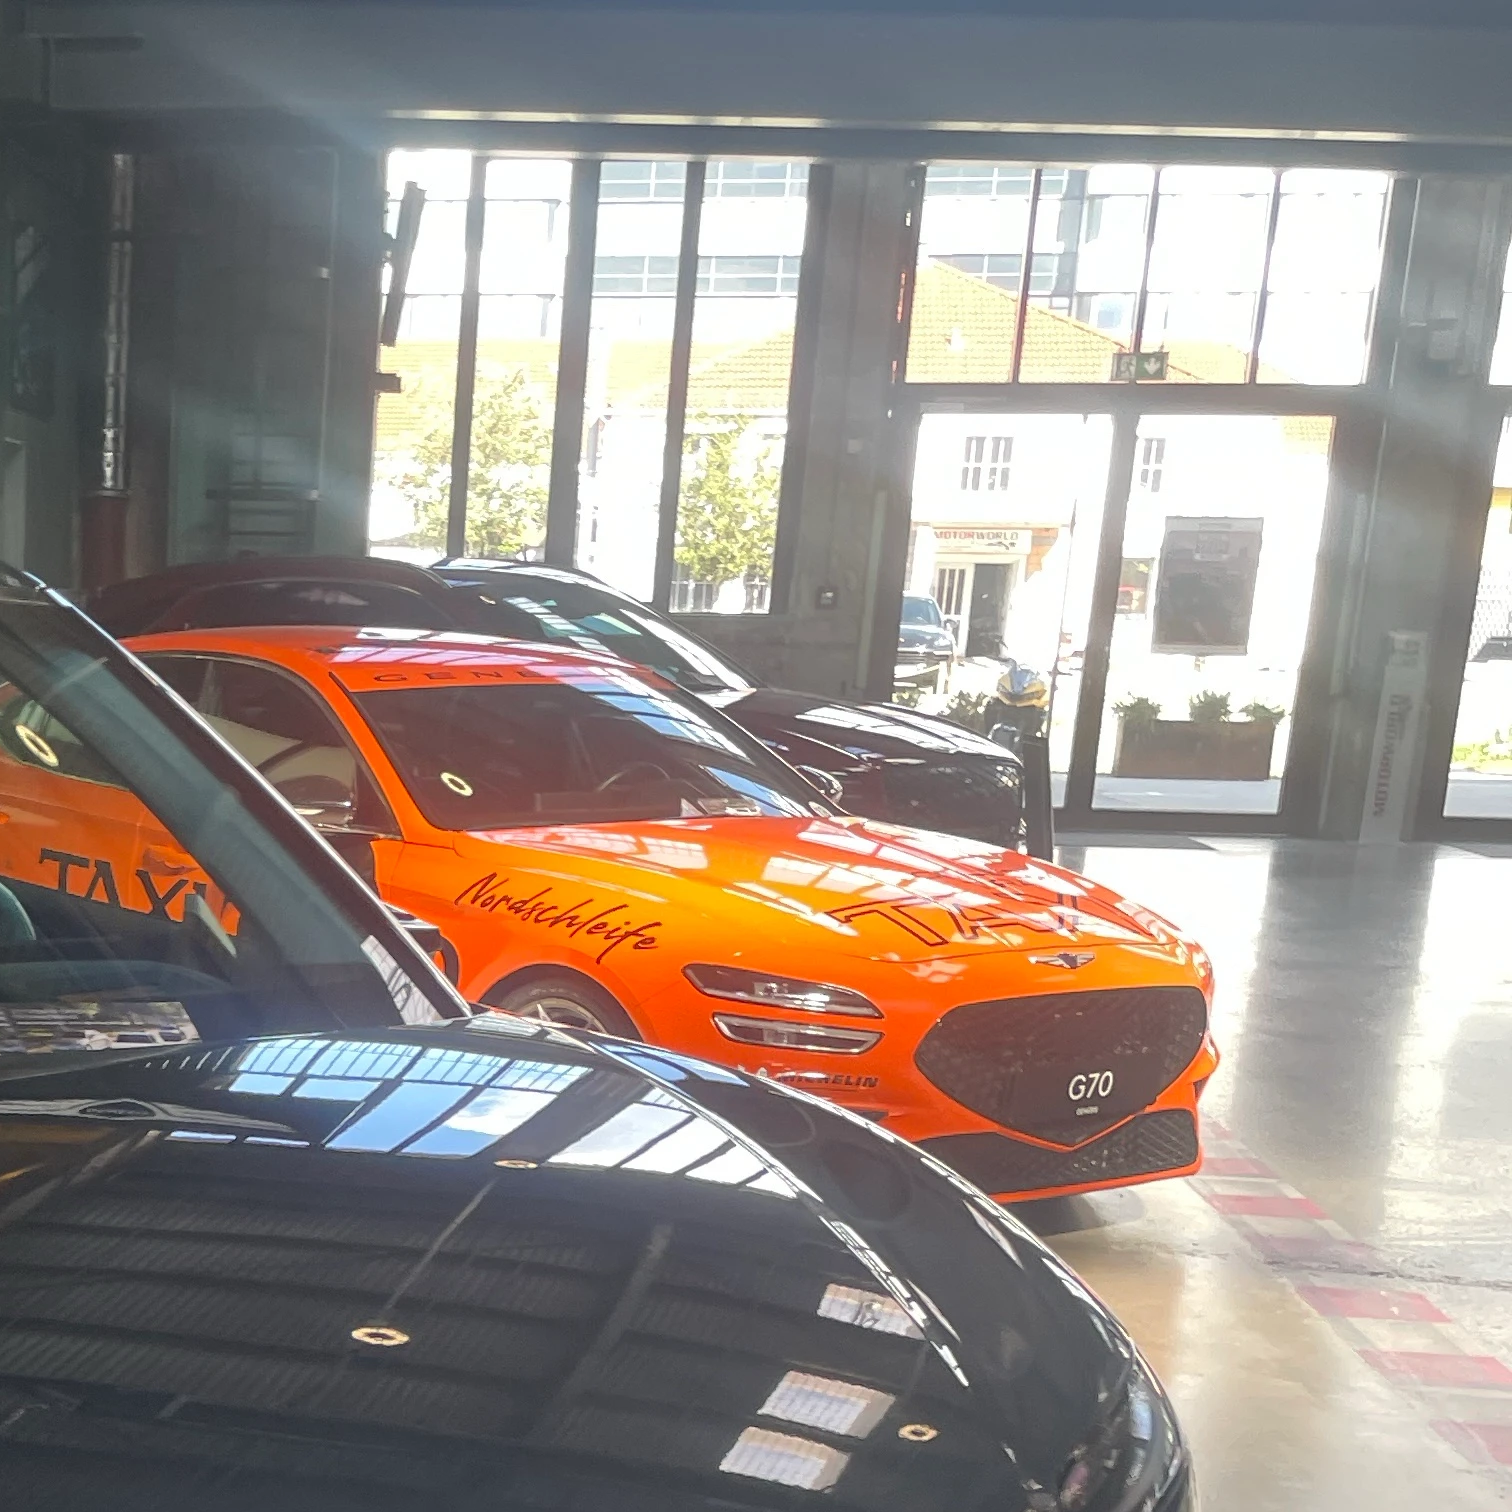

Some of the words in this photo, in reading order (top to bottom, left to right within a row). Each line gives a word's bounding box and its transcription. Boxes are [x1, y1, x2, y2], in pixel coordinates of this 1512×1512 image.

[934, 530, 1019, 541] MOTORWORLD
[454, 872, 662, 965] Nordschleife
[1068, 1070, 1114, 1101] G70
